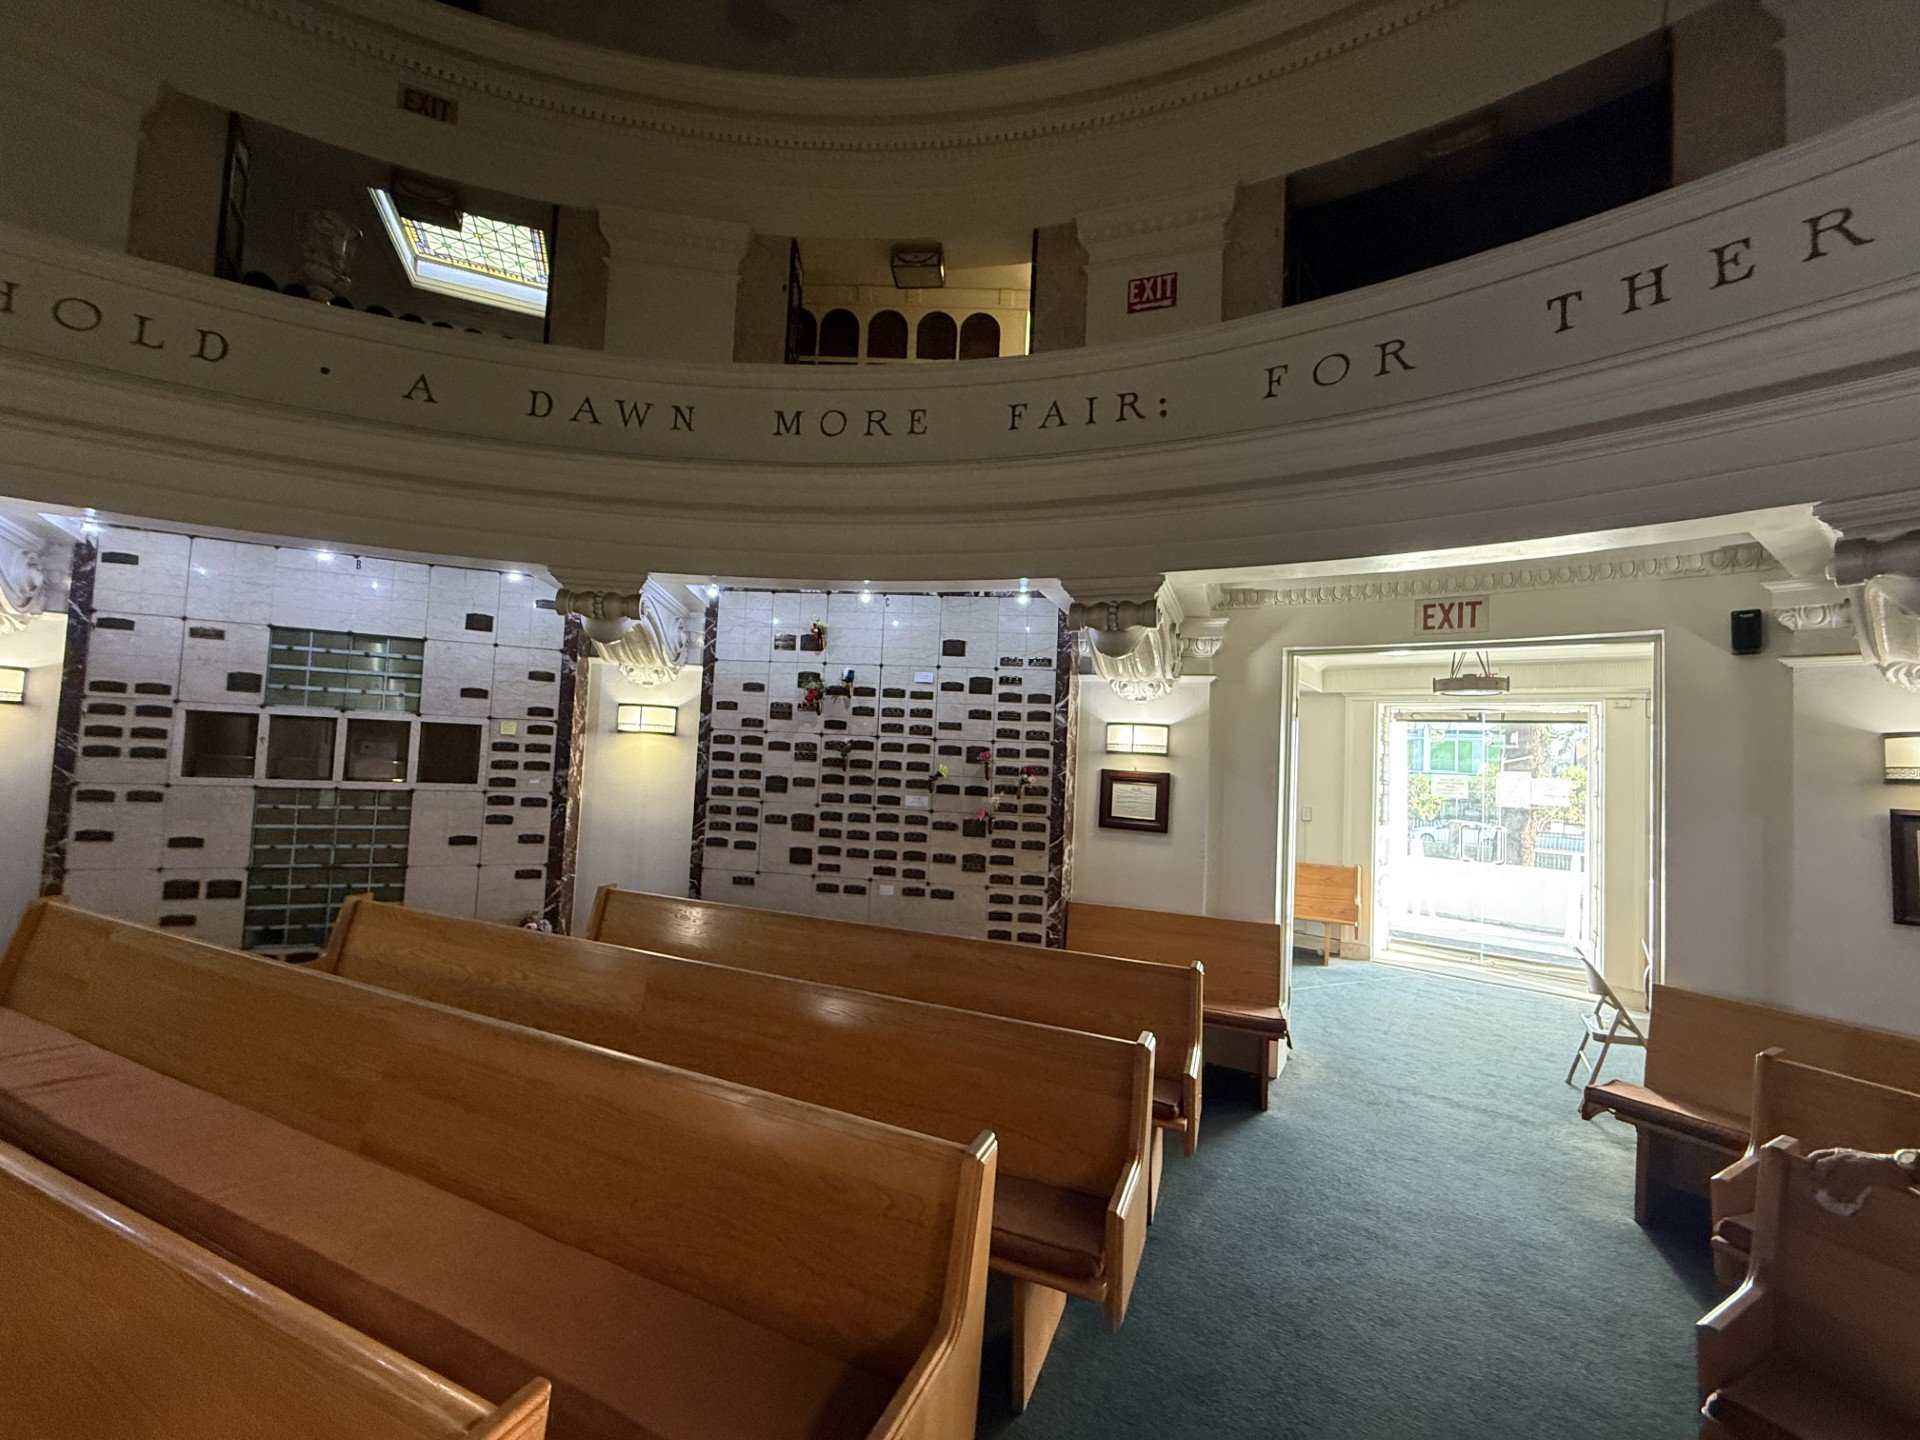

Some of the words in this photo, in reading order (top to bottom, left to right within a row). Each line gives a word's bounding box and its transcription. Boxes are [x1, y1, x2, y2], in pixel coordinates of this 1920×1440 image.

[403, 88, 451, 122] EXIT
[1129, 274, 1176, 304] EXIT
[401, 373, 438, 404] A
[525, 389, 696, 432] DAWN
[772, 408, 929, 438] MORE
[1007, 391, 1169, 431] FAIR:
[1262, 338, 1418, 400] FOR
[1546, 206, 1877, 336] THER
[1422, 600, 1483, 630] EXIT
